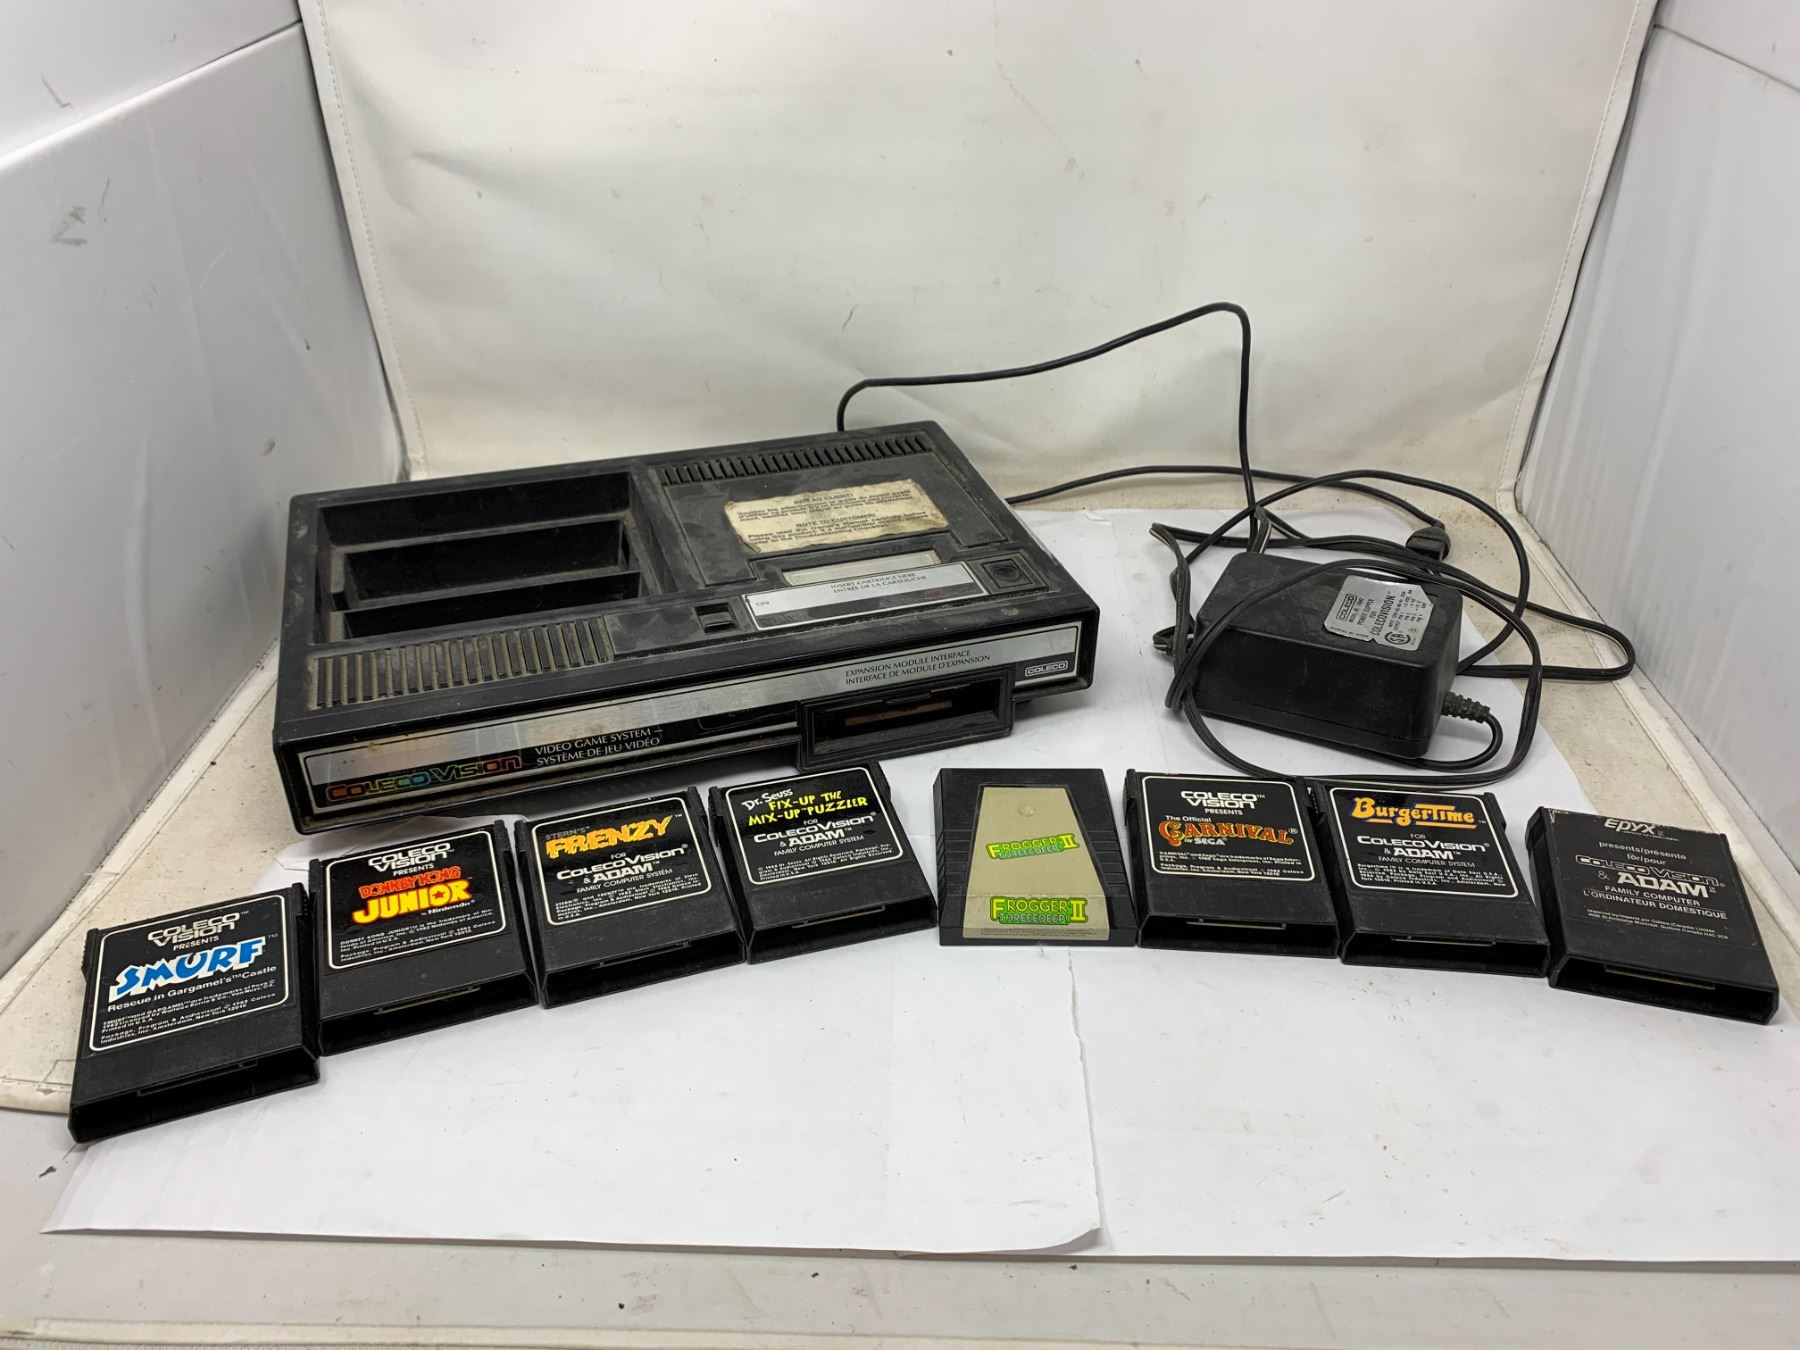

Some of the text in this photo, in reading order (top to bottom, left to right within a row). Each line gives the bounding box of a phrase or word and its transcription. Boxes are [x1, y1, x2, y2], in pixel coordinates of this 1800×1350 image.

[831, 581, 856, 590] INSERT
[881, 575, 928, 588] CARTOUCHE
[1338, 594, 1355, 621] COLECO
[1370, 594, 1397, 637] COLECOVISION
[845, 650, 971, 678] EXPANSION MODULE INTERFACE
[845, 654, 991, 685] INTERFACE DE MODULE D'EXPANSION
[1028, 663, 1065, 675] COLECO
[535, 728, 651, 756] VIDEO GAME SYSTEM
[536, 736, 661, 767] SYSTÈME DE JEU VIDÉO
[741, 789, 793, 811] Dr. Seuss
[768, 790, 842, 812] FIX-UP THE
[1180, 790, 1258, 802] COLECO
[1186, 798, 1256, 809] VISION
[749, 797, 869, 827] MIX-UP PUZZLER
[803, 818, 818, 826] FOR
[1182, 815, 1212, 823] Official
[1204, 807, 1244, 816] PRESENTS
[1352, 797, 1475, 828] BurgerTime
[545, 815, 673, 859] FRENZY
[779, 828, 846, 848] & ADAM
[1158, 820, 1295, 847] CARNIVAL
[1193, 837, 1226, 847] SEGA
[368, 842, 451, 867] COLECO
[610, 852, 627, 860] FOR
[773, 835, 864, 857] FAMILY COMPUTER SYSTEM
[987, 834, 1077, 859] FROGGER II
[1394, 847, 1454, 861] ADAM
[373, 852, 448, 873] VISION
[393, 862, 434, 877] PRESENTS
[583, 862, 654, 884] & ADAM
[1378, 856, 1476, 868] FAMILY COMPUTER SYSTEM
[358, 866, 462, 899] DONKEY KONG
[576, 883, 602, 894] FAMILY
[603, 874, 644, 888] COMPUTER
[646, 868, 673, 880] SYSTEM
[1598, 870, 1709, 898] & ADAM
[352, 879, 472, 924] JUNIOR
[1583, 889, 1728, 920] L'ORDINATEUR DOMESTIQUE
[1605, 885, 1701, 907] FAMILY COMPUTER
[428, 902, 471, 915] Nintendo
[992, 898, 1086, 920] FROGGER II
[148, 912, 240, 942] COLECO
[152, 920, 235, 948] VISION
[173, 935, 219, 951] PRESENTS
[108, 936, 266, 1003] SMURF
[107, 995, 151, 1013] Rescue
[154, 993, 165, 1001] in
[242, 965, 277, 980] Castle
